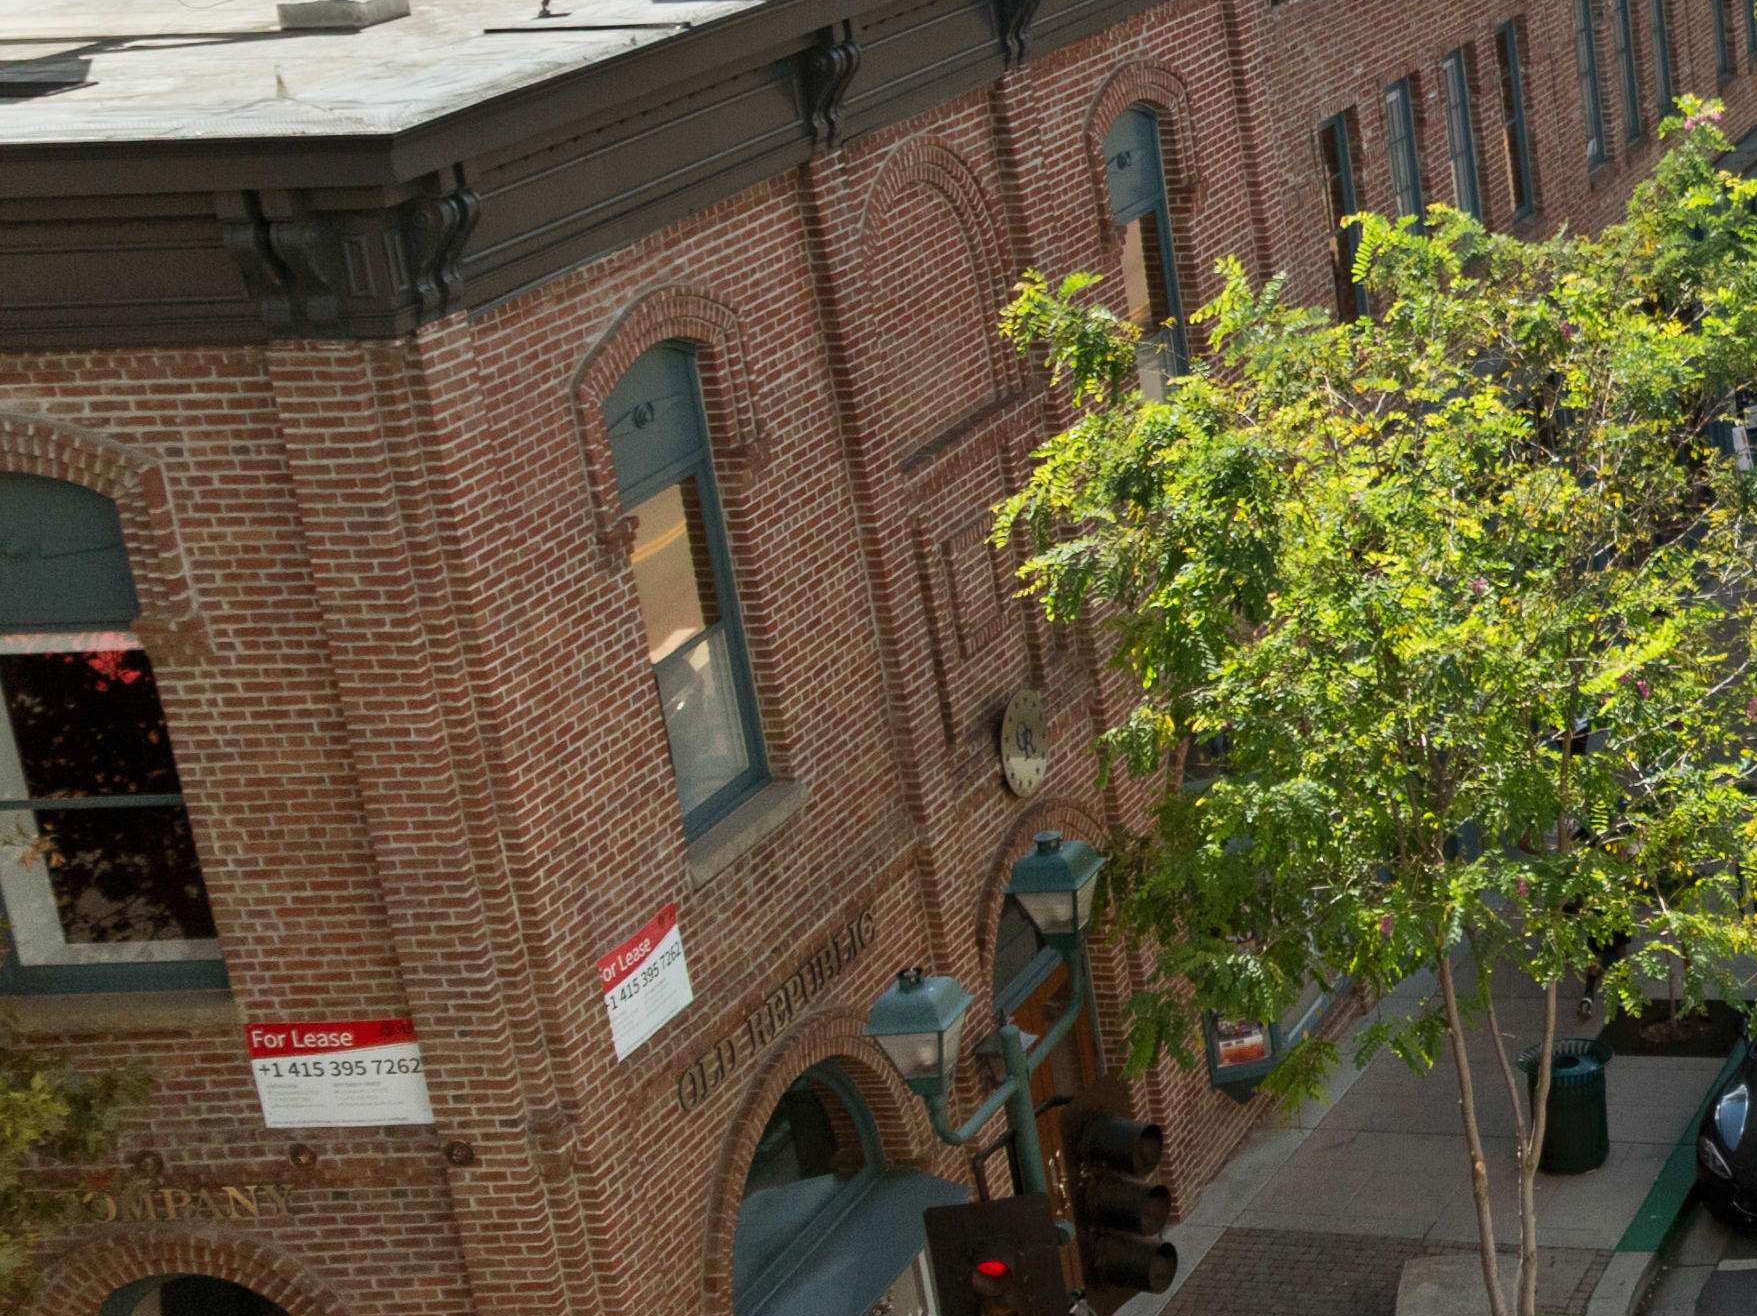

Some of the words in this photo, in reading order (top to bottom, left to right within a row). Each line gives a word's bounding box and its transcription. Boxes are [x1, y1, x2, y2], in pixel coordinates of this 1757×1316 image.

[617, 938, 651, 972] Lease
[620, 978, 641, 1003] 415
[641, 963, 660, 987] 395
[660, 941, 682, 971] 7262
[678, 1036, 736, 1111] OLD
[744, 909, 875, 1055] REPUBLIC
[252, 1030, 285, 1048] For
[291, 1030, 353, 1048] Lease
[258, 1063, 283, 1078] +1
[288, 1062, 325, 1078] 415
[330, 1061, 367, 1077] 395
[371, 1058, 423, 1076] 7262
[82, 1184, 295, 1223] OMPANY
